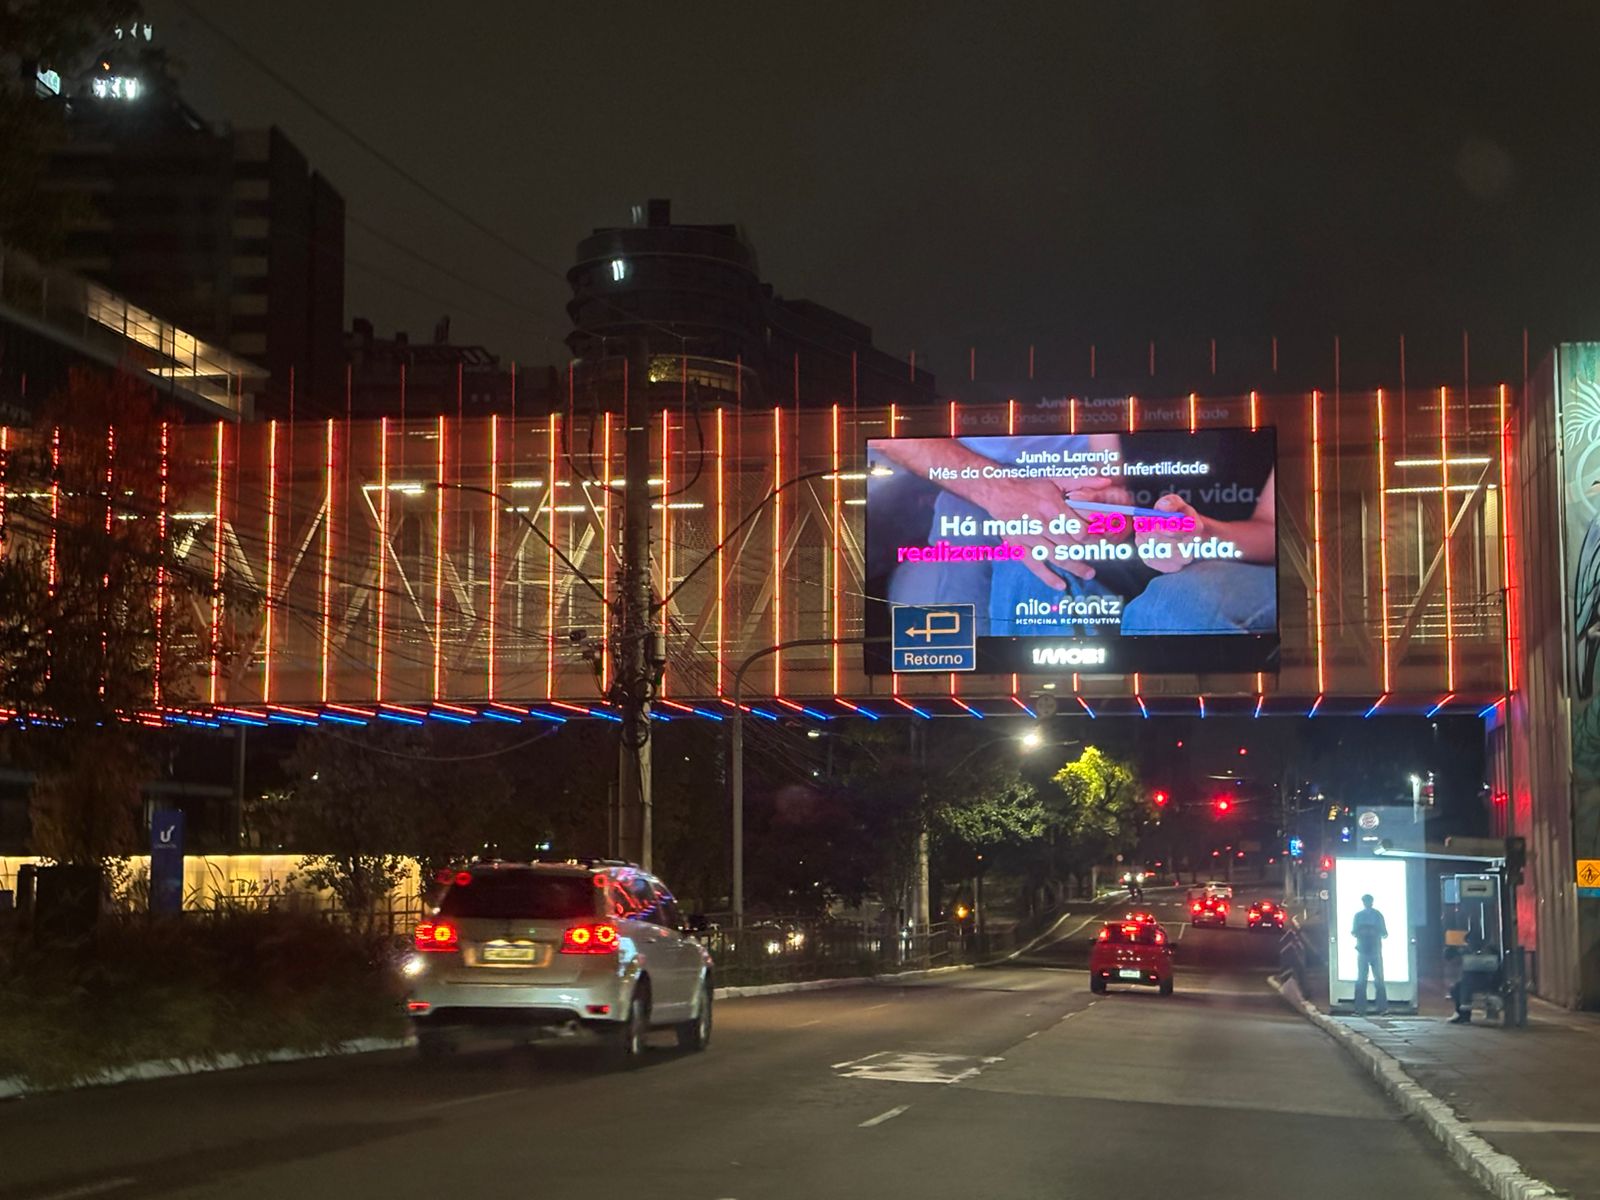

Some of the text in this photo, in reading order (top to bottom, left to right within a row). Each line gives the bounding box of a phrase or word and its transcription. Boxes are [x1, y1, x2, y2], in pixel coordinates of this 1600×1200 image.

[1016, 449, 1120, 464] Junho Laranja
[928, 461, 1210, 480] Mês da Conscientização da Infertilidade
[940, 512, 1197, 537] Há mais de 20 anos
[897, 536, 1243, 563] realizando o sonho da vida.
[1060, 617, 1121, 625] REPRODUTIVA
[904, 652, 963, 666] Retorno
